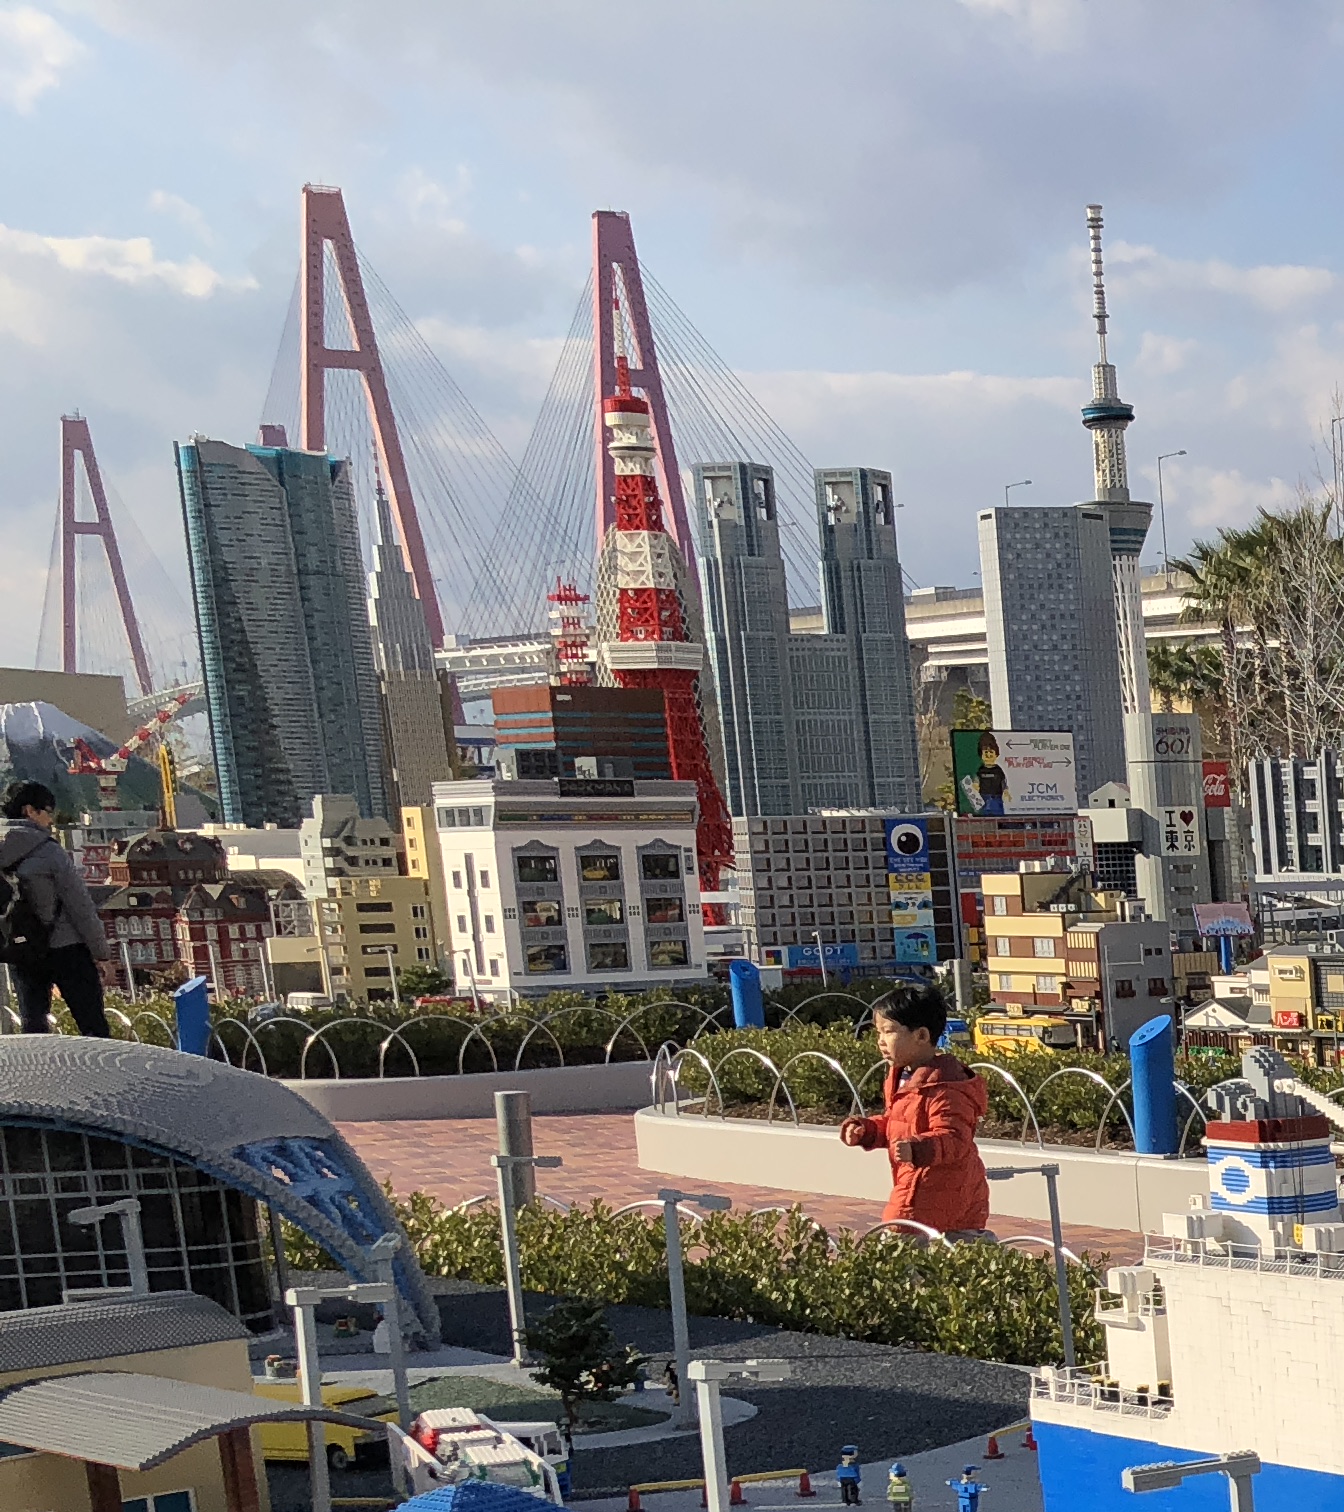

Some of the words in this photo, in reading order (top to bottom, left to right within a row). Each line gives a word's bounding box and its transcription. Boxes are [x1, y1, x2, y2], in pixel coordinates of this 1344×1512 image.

[1156, 735, 1191, 755] 601
[1027, 782, 1058, 794] JCM
[1165, 829, 1196, 852] 東京
